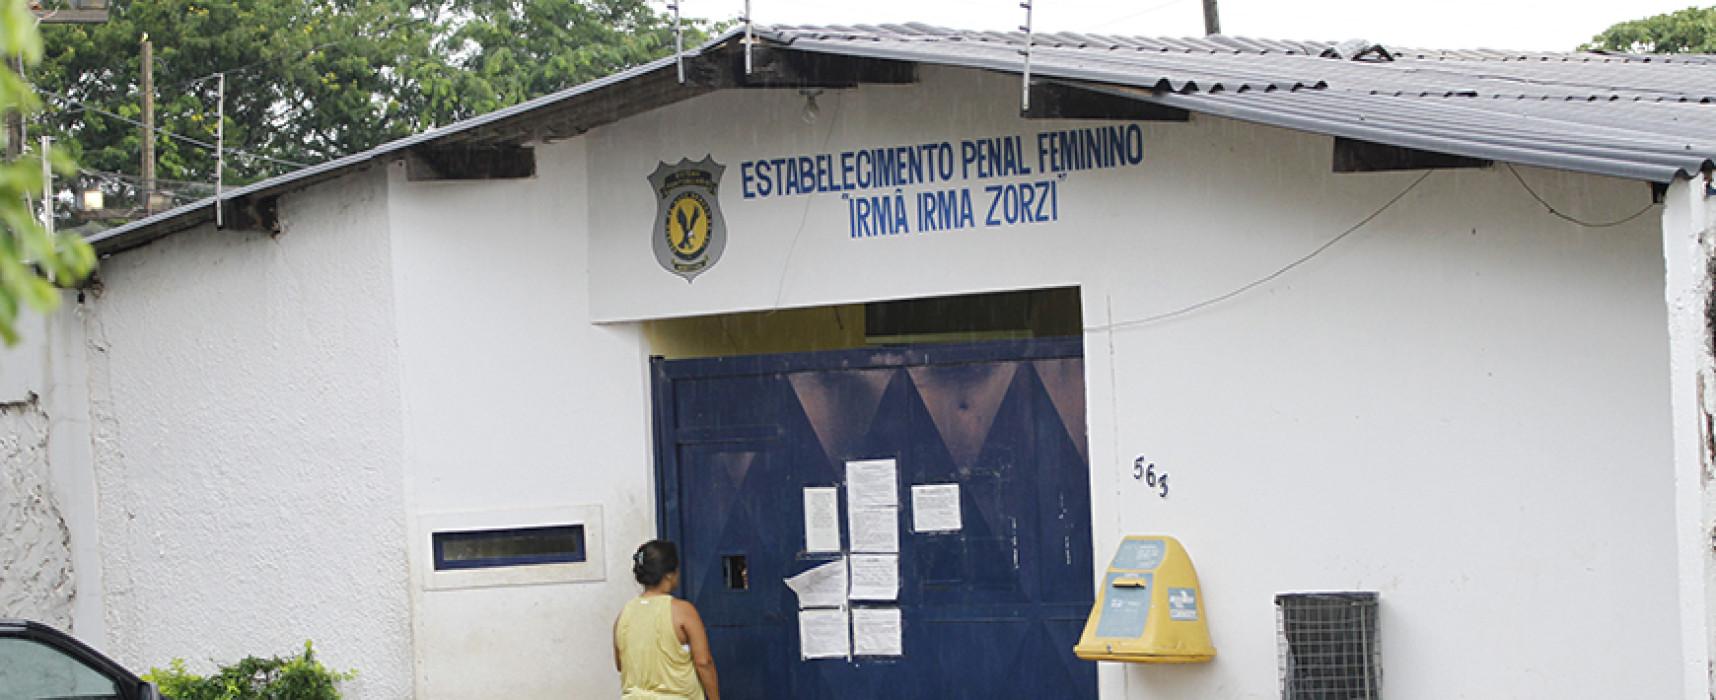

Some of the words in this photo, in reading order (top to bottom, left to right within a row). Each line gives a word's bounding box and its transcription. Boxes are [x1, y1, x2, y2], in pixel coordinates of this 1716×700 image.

[740, 141, 955, 199] ESTABELECIMENTO
[961, 135, 1031, 180] PENAL
[1037, 123, 1144, 174] FEMININO
[916, 187, 975, 233] IRMA
[1133, 455, 1169, 498] 563
